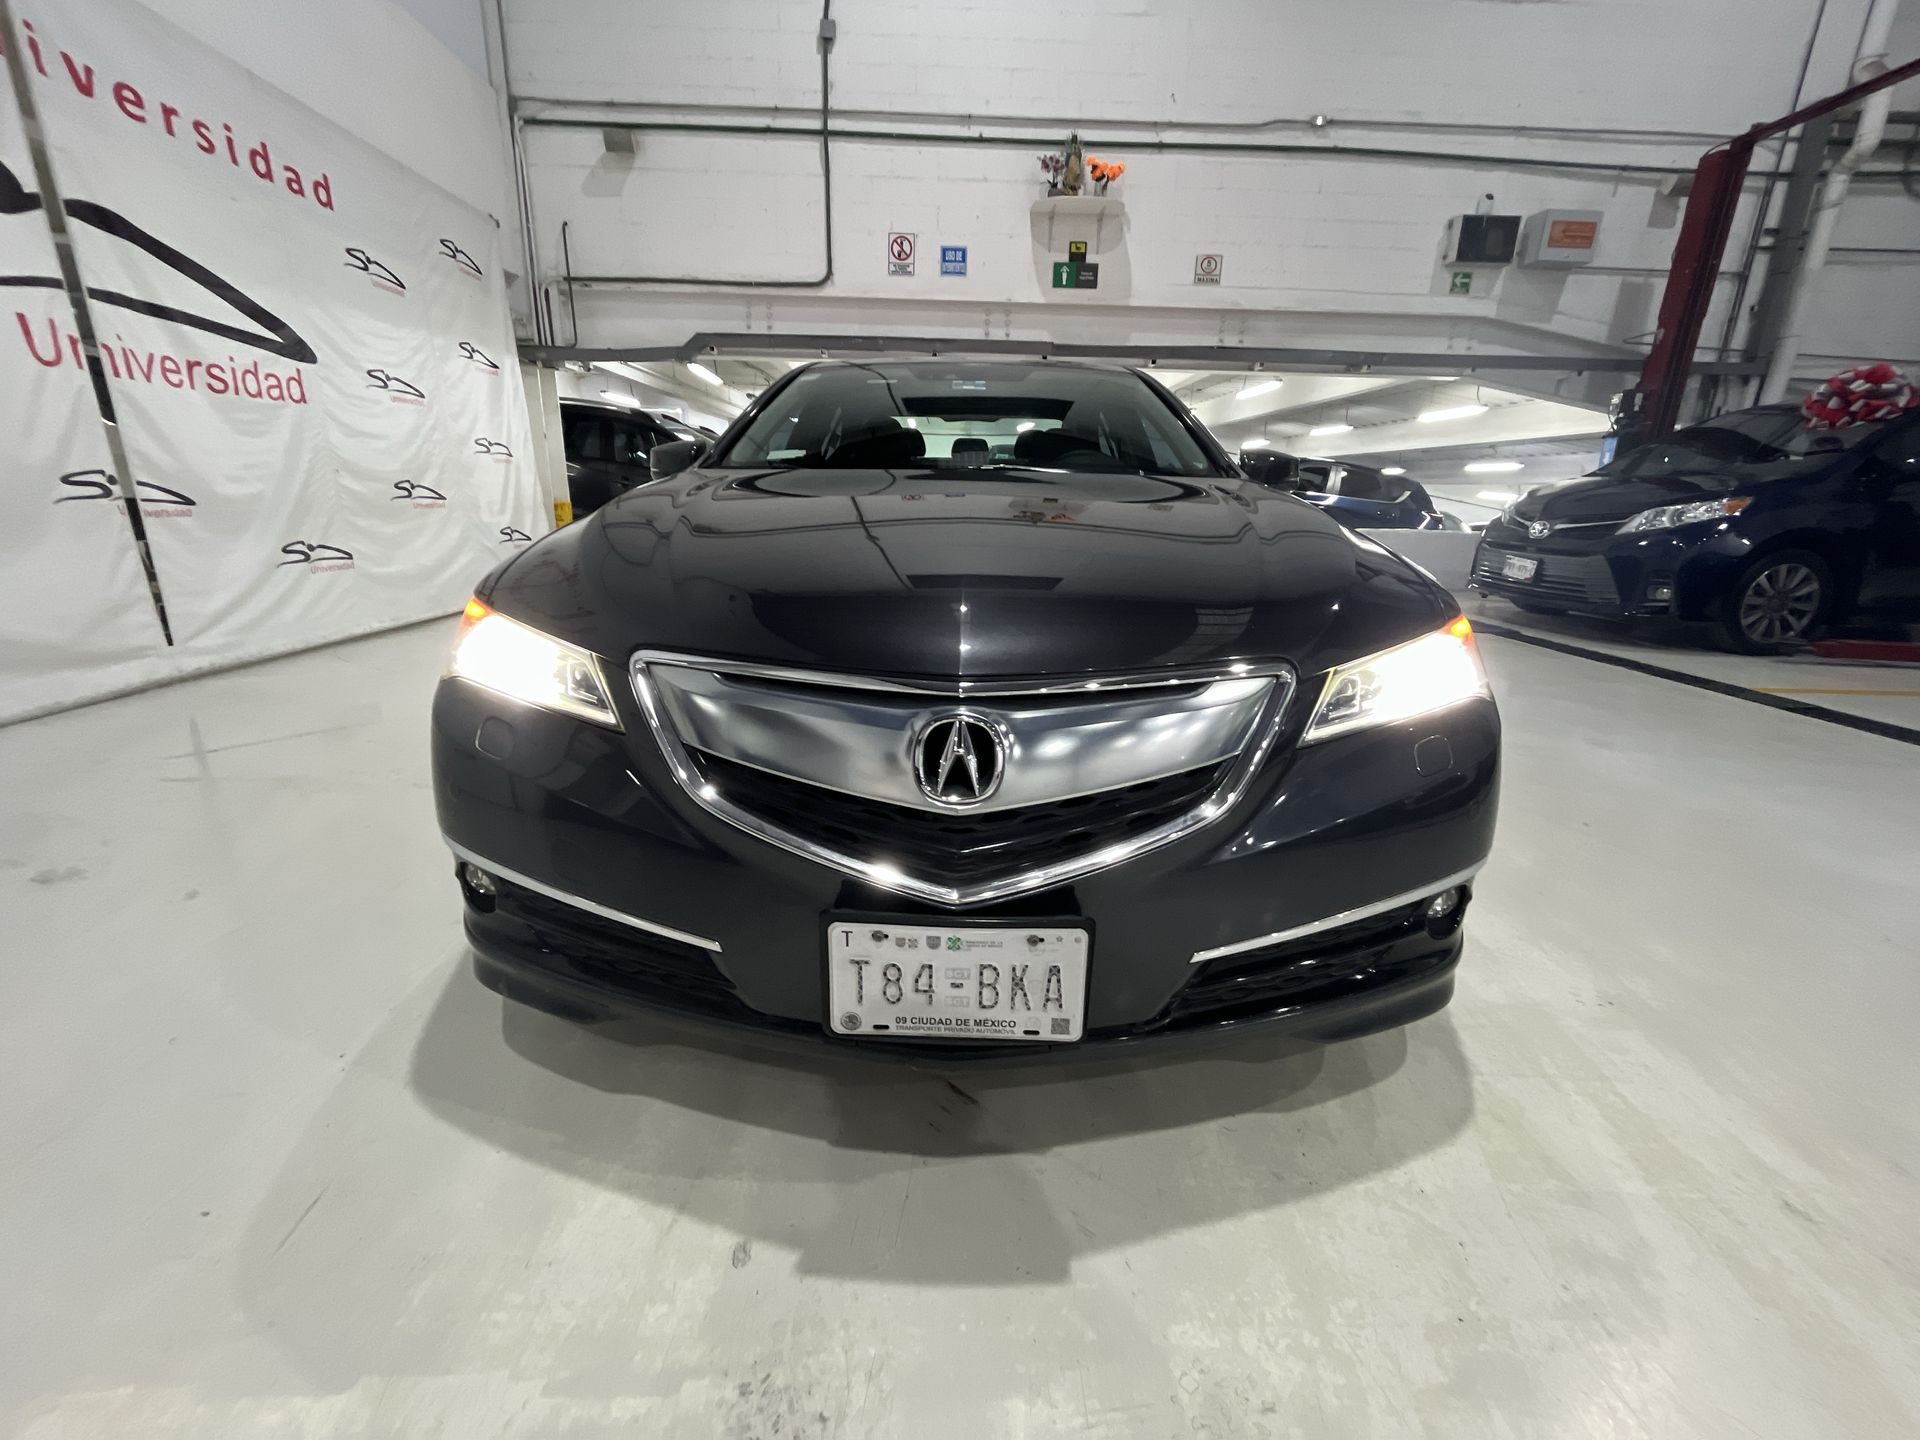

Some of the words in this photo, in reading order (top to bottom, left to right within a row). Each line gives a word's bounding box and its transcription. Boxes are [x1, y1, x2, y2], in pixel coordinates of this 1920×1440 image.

[0, 18, 335, 211] iversidad
[15, 311, 309, 405] Universidad
[841, 930, 853, 947] T
[850, 958, 1063, 1011] T84-BKA
[895, 1016, 907, 1025] 09
[910, 1016, 952, 1027] CIUDAD
[955, 1018, 971, 1027] DE
[973, 1017, 1017, 1029] MÉXICO
